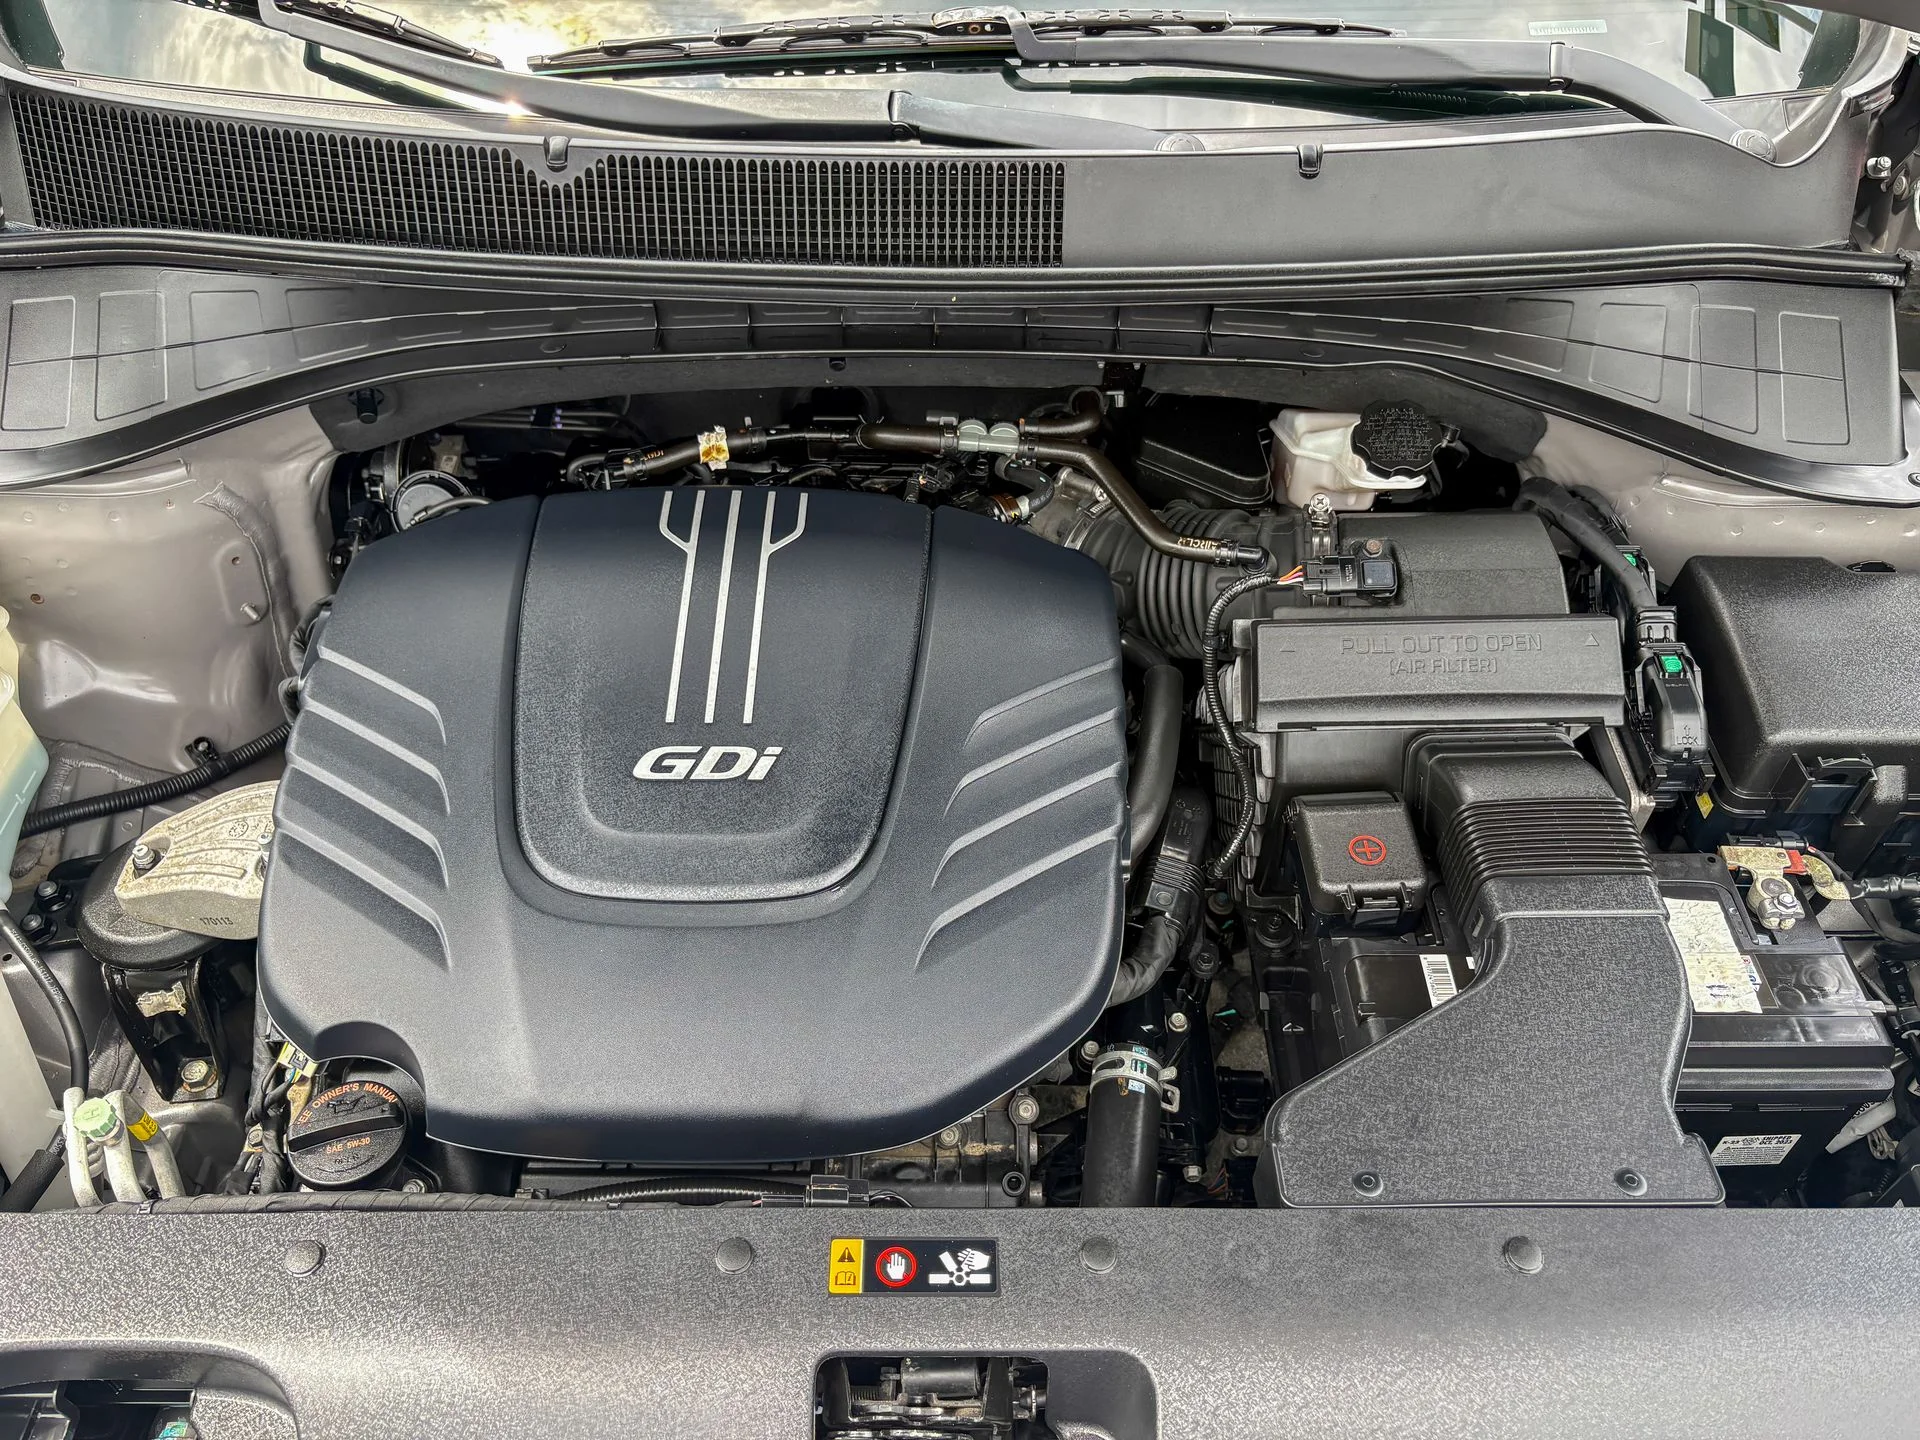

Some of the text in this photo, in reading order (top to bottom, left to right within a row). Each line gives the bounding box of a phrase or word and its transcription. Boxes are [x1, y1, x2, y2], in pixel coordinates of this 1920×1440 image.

[1341, 633, 1542, 655] PULL OUT TO OPEN
[1676, 736, 1699, 746] LOCK
[632, 745, 784, 781] GDi
[200, 917, 234, 926] 170113
[312, 1082, 360, 1109] OWNER'S
[326, 1137, 371, 1154] SAE 5W-30
